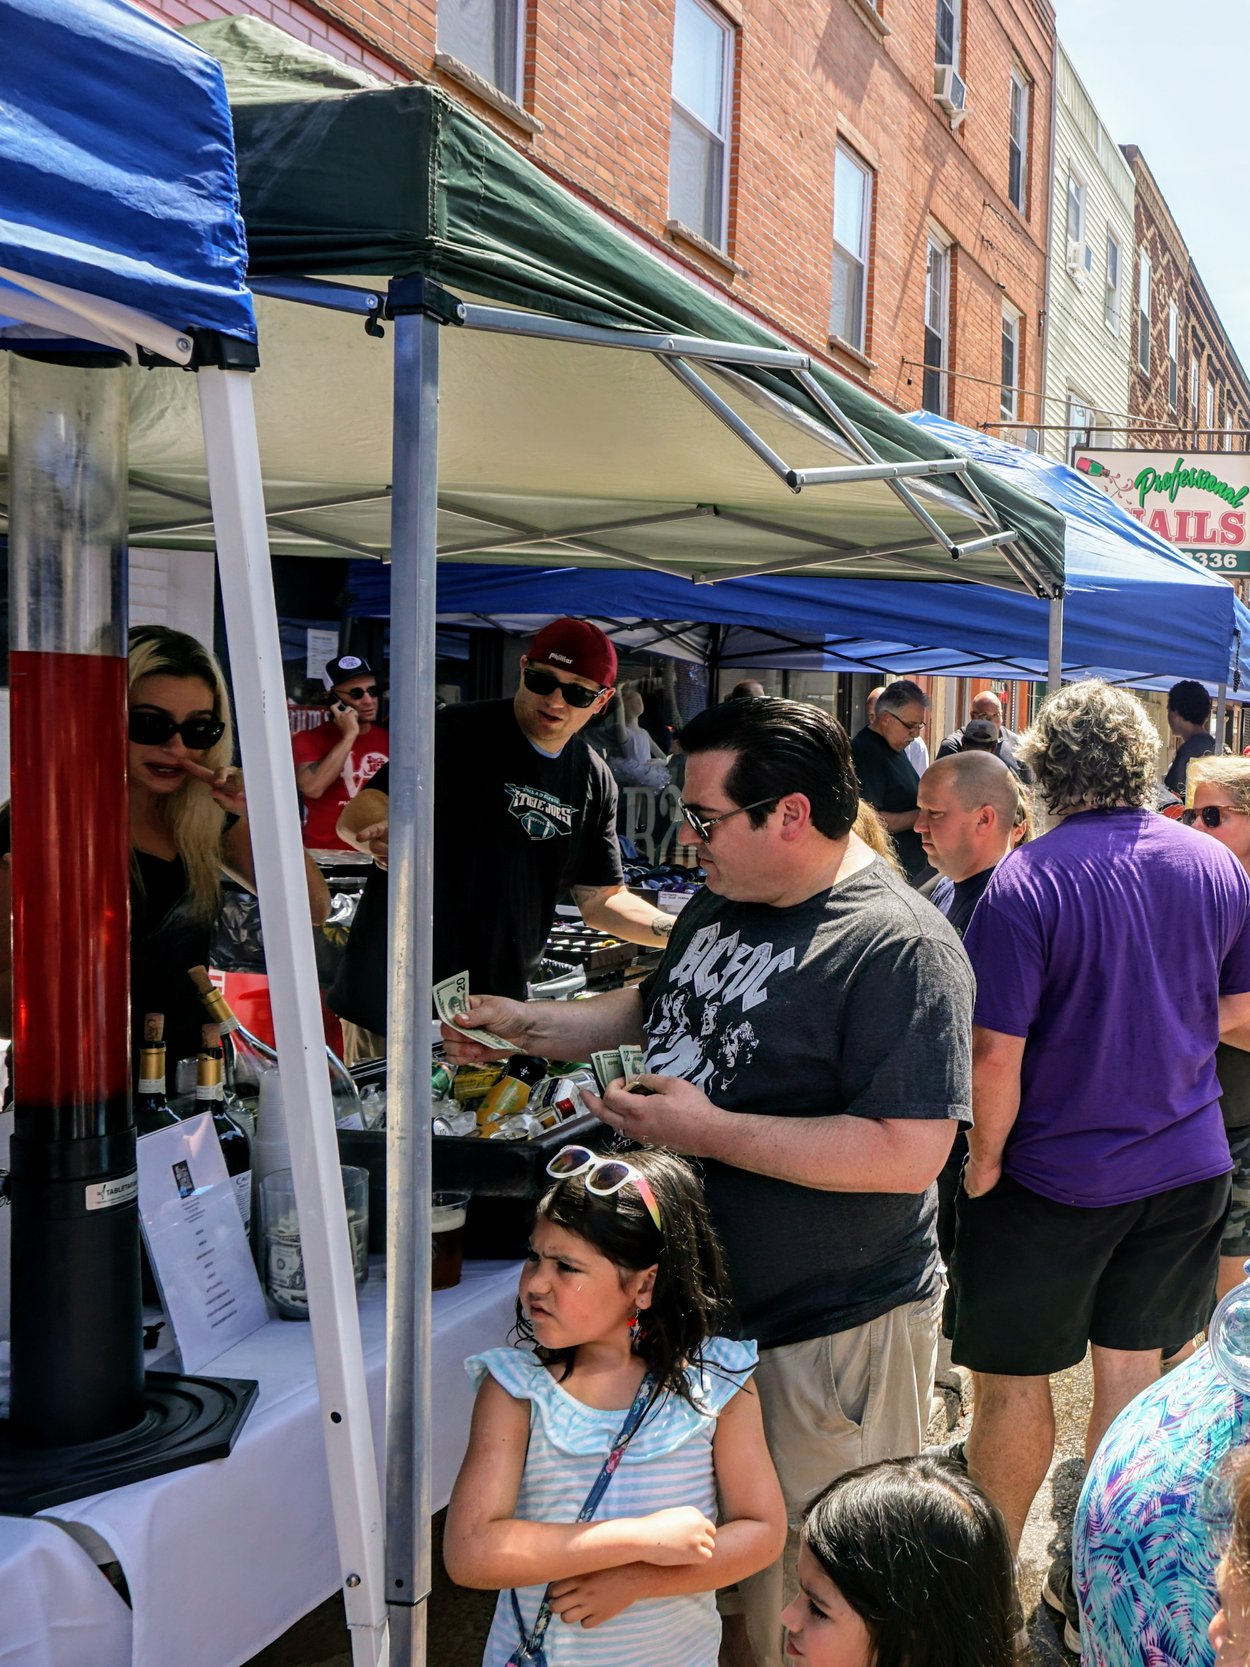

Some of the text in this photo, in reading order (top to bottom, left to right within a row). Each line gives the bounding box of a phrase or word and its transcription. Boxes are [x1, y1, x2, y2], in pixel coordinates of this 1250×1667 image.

[1134, 457, 1249, 509] Professional
[1183, 552, 1238, 569] 336
[456, 976, 466, 994] 20
